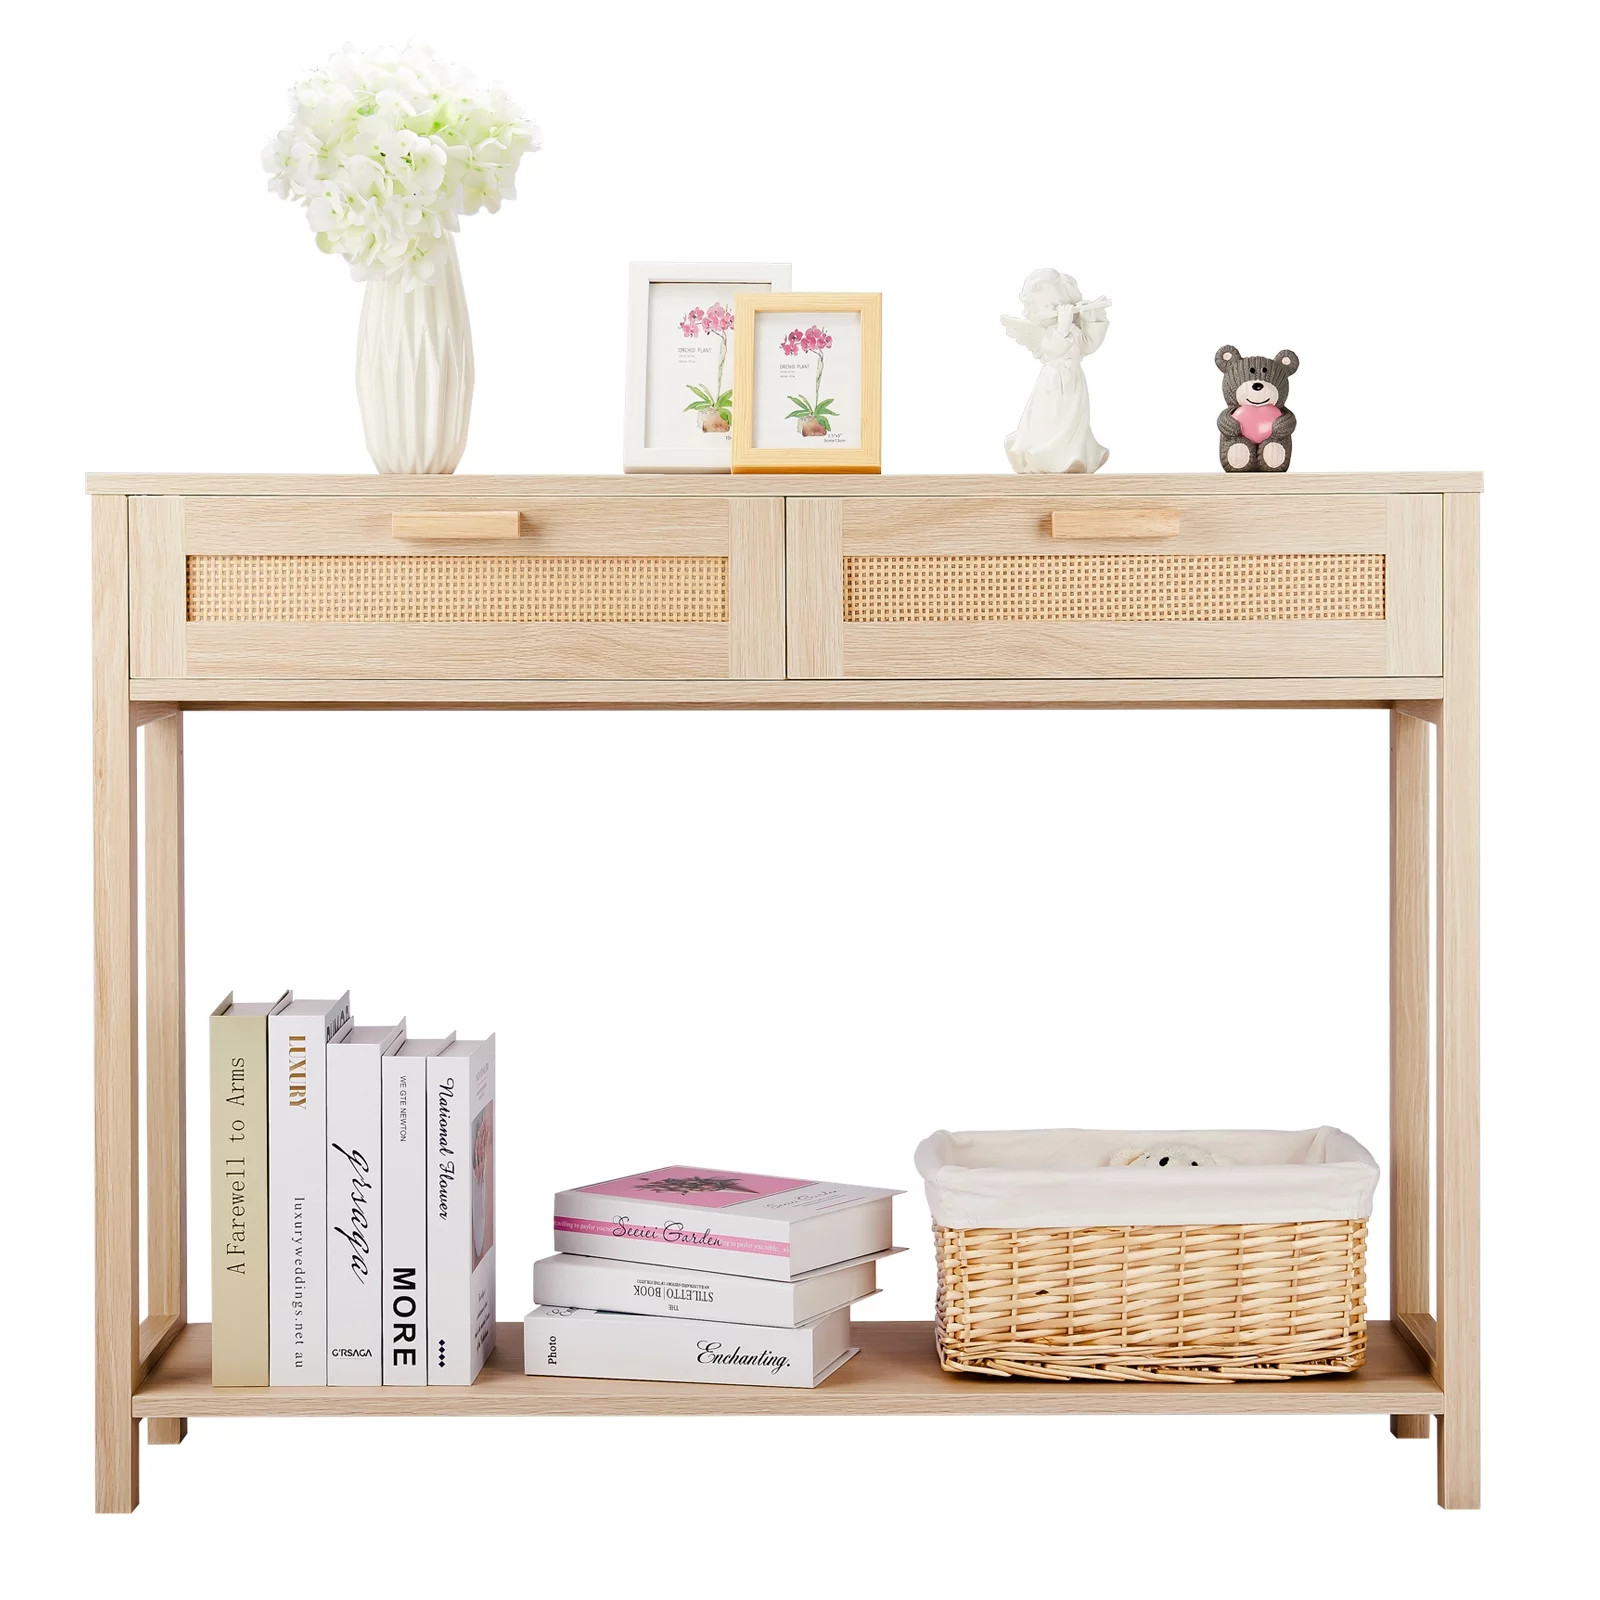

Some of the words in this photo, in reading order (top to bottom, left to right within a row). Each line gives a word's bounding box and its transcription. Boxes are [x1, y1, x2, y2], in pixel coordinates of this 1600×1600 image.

[226, 1057, 245, 1107] Arms
[288, 1035, 307, 1109] LUXURY
[399, 1075, 407, 1088] WE
[399, 1090, 407, 1105] GTE
[228, 1119, 245, 1143] to
[399, 1108, 407, 1142] NEWTON
[438, 1077, 455, 1157] National
[438, 1160, 455, 1221] Flower
[226, 1157, 245, 1255] Farewell
[662, 1220, 722, 1246] Garden
[226, 1263, 245, 1275] A
[633, 1284, 661, 1298] BOOK
[667, 1287, 714, 1303] STILETTO
[392, 1267, 417, 1367] MORE
[668, 1304, 680, 1312] THE
[295, 1351, 303, 1368] au
[547, 1335, 557, 1365] Photo
[696, 1339, 791, 1376] Enchanting.
